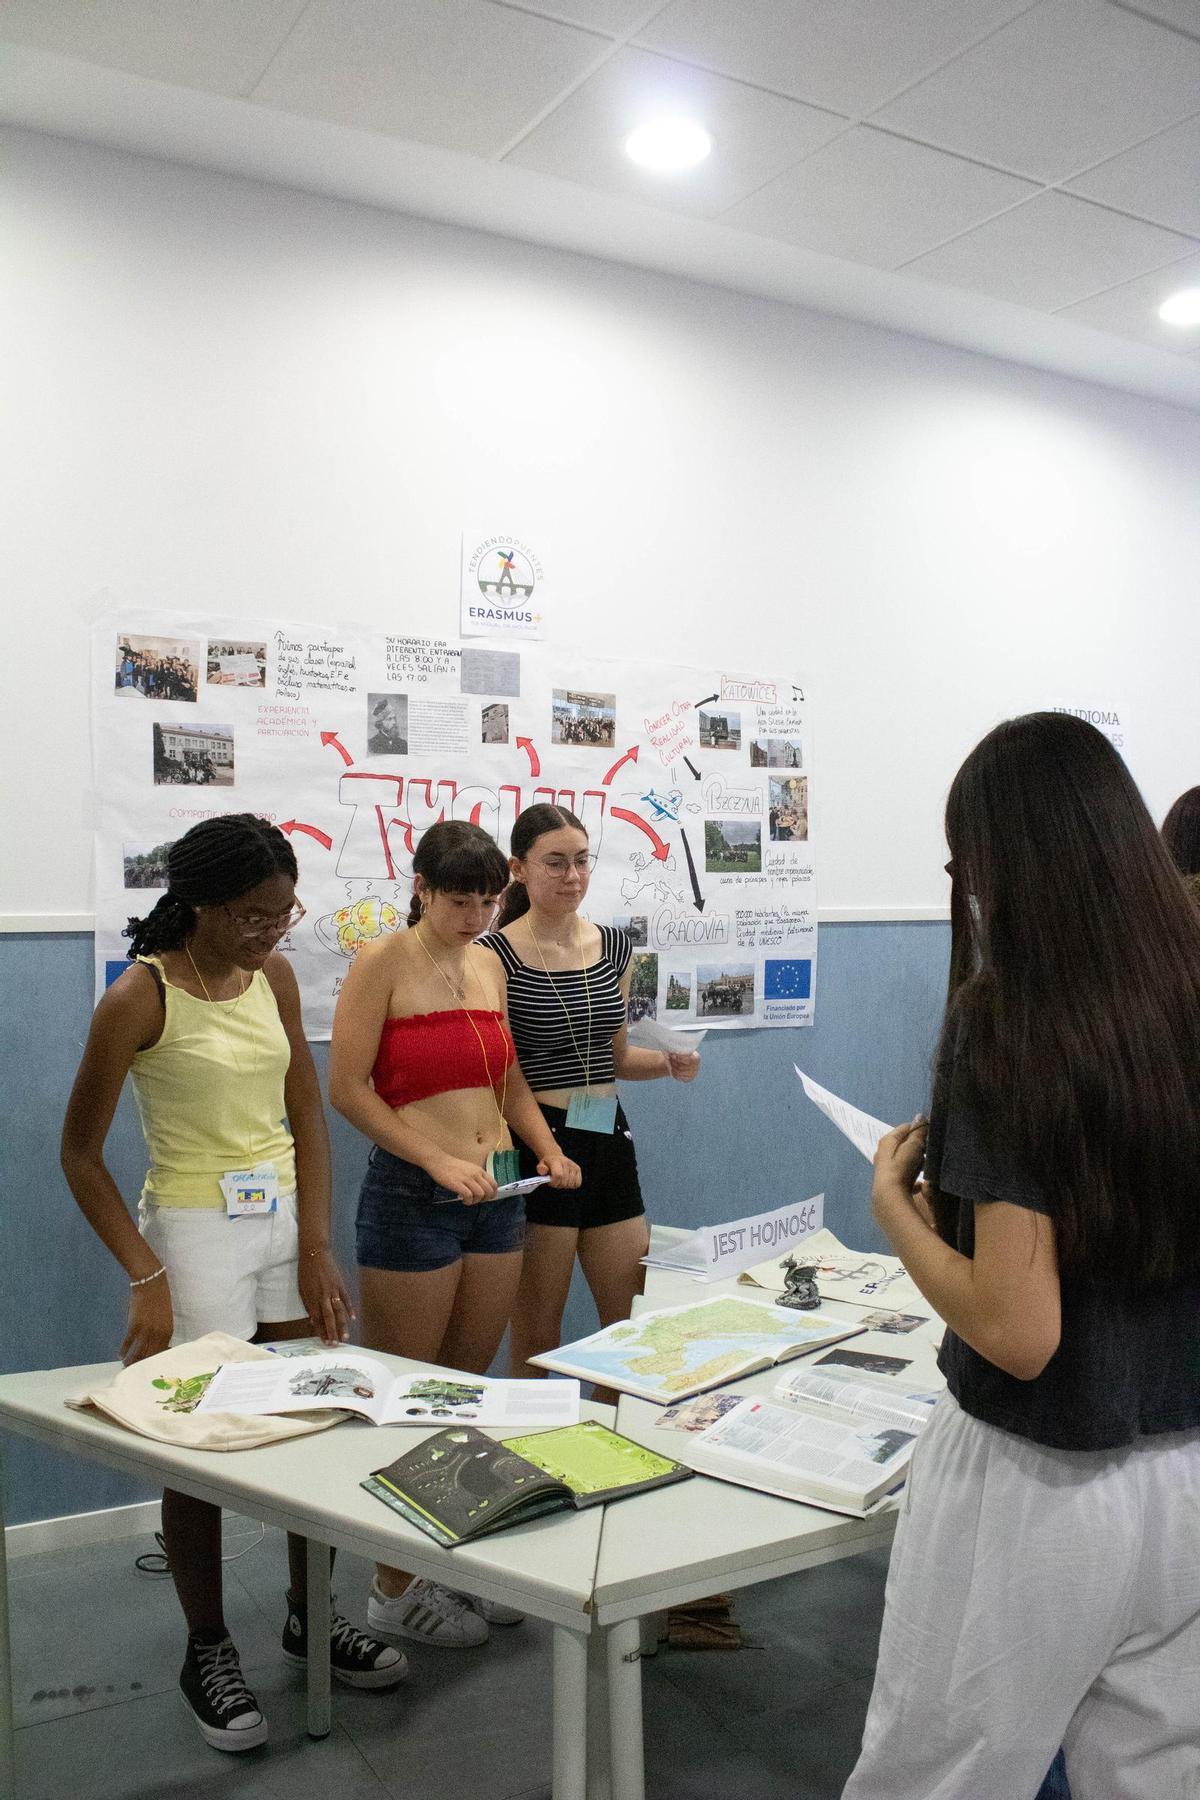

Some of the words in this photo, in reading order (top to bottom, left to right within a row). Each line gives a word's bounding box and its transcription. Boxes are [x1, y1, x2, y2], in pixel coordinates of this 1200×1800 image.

[722, 684, 770, 700] KATOWICE
[798, 1004, 806, 1013] por
[713, 1228, 746, 1263] JEST
[751, 1205, 816, 1248] HOJNOŚĆ
